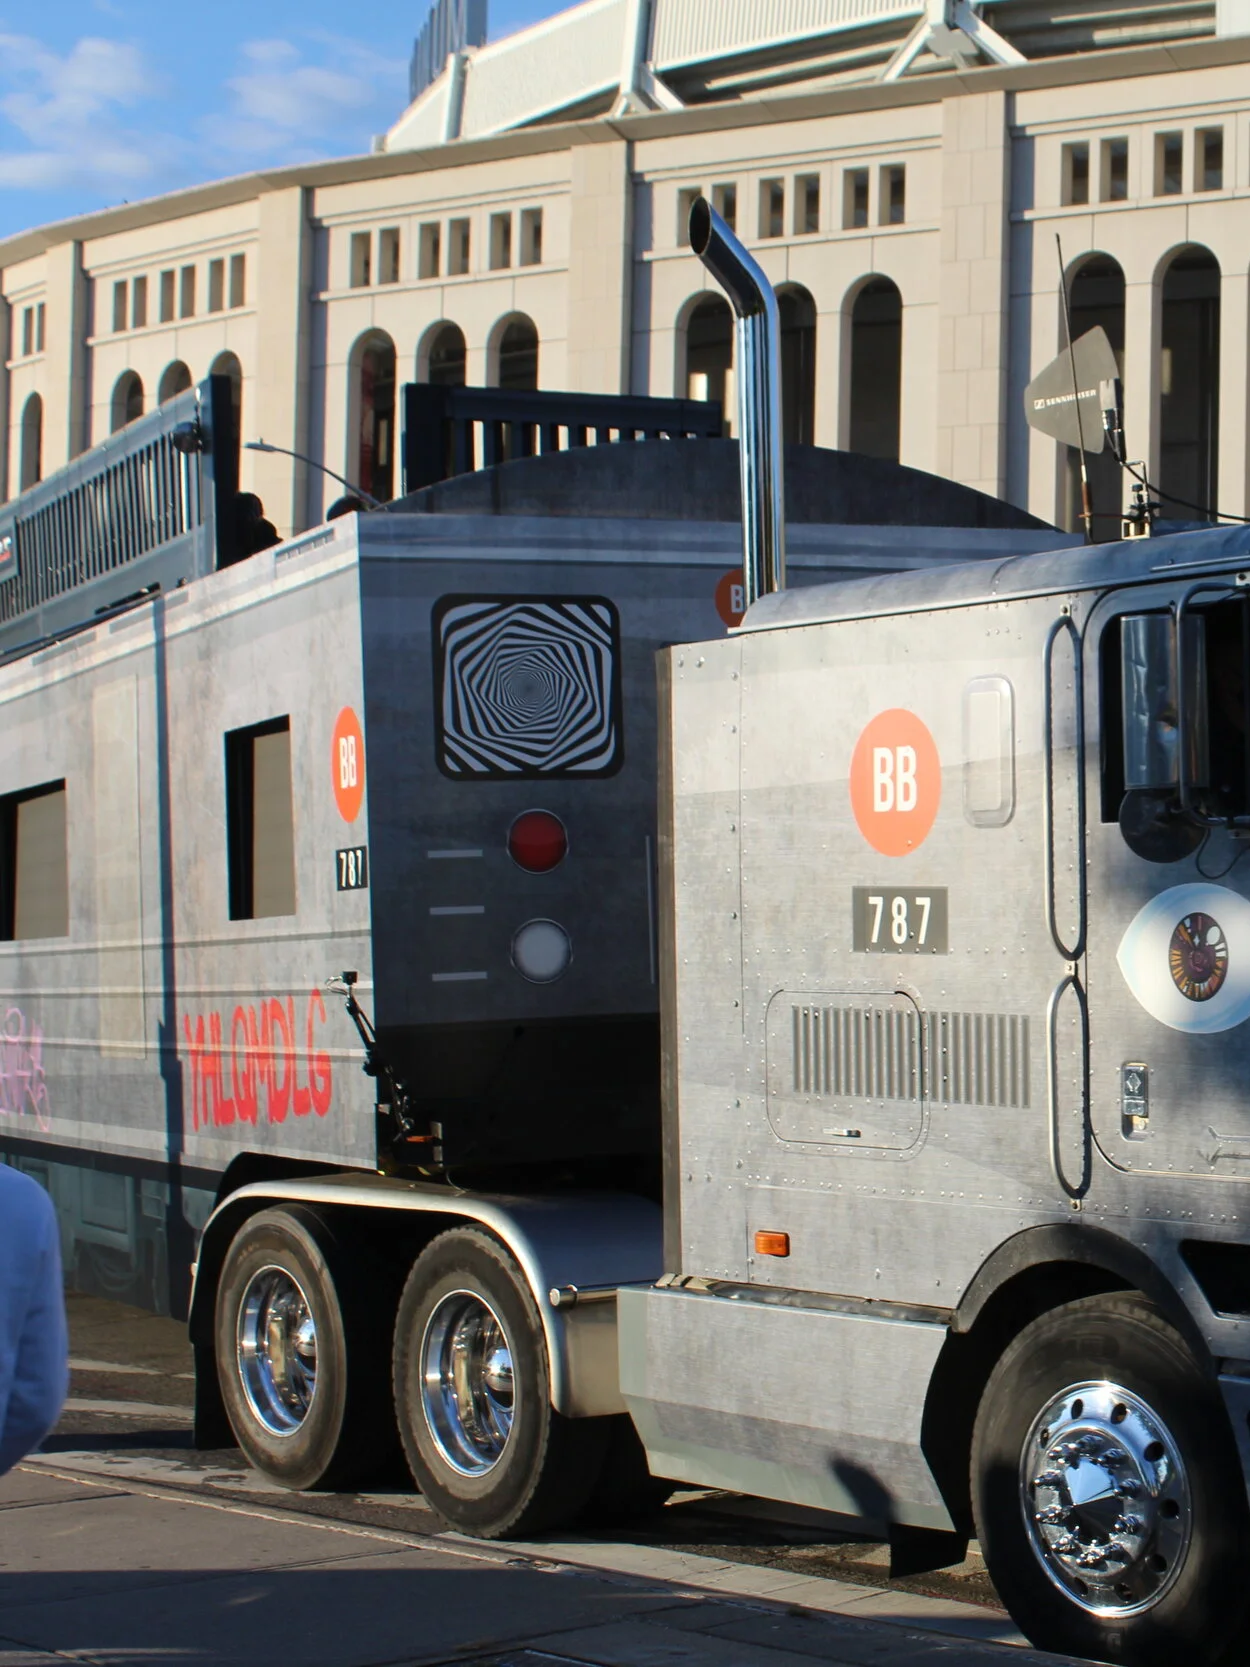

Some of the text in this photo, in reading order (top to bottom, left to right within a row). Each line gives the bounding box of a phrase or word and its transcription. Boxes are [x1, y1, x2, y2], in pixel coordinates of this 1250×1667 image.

[339, 735, 357, 789] BB
[873, 745, 917, 812] BB
[339, 849, 363, 888] 787
[868, 896, 931, 944] 787
